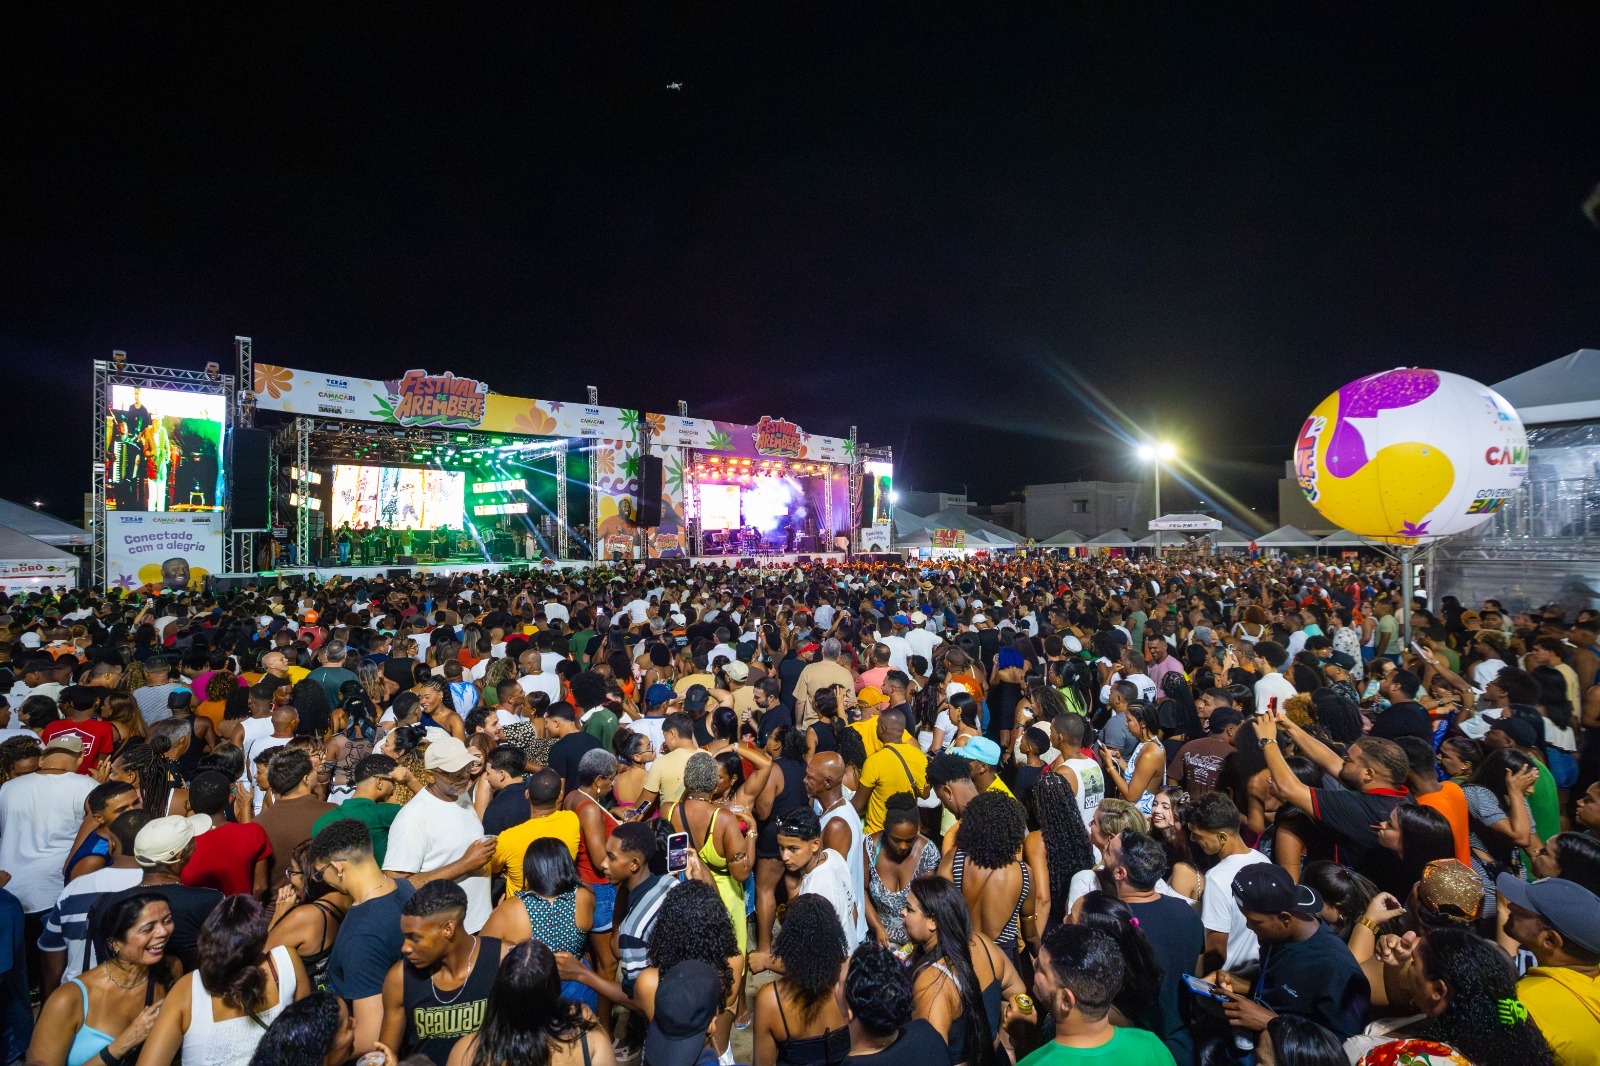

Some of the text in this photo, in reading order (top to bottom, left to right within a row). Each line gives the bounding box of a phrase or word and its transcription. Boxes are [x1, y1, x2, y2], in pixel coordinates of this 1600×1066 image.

[400, 371, 484, 399] FESTIVAL
[395, 392, 484, 419] AREMBEPE
[456, 410, 480, 421] 2026
[760, 416, 801, 438] FESTIVAL
[757, 431, 800, 450] AREMBEPE
[124, 530, 193, 545] Conectado
[128, 540, 206, 555] com a alegria
